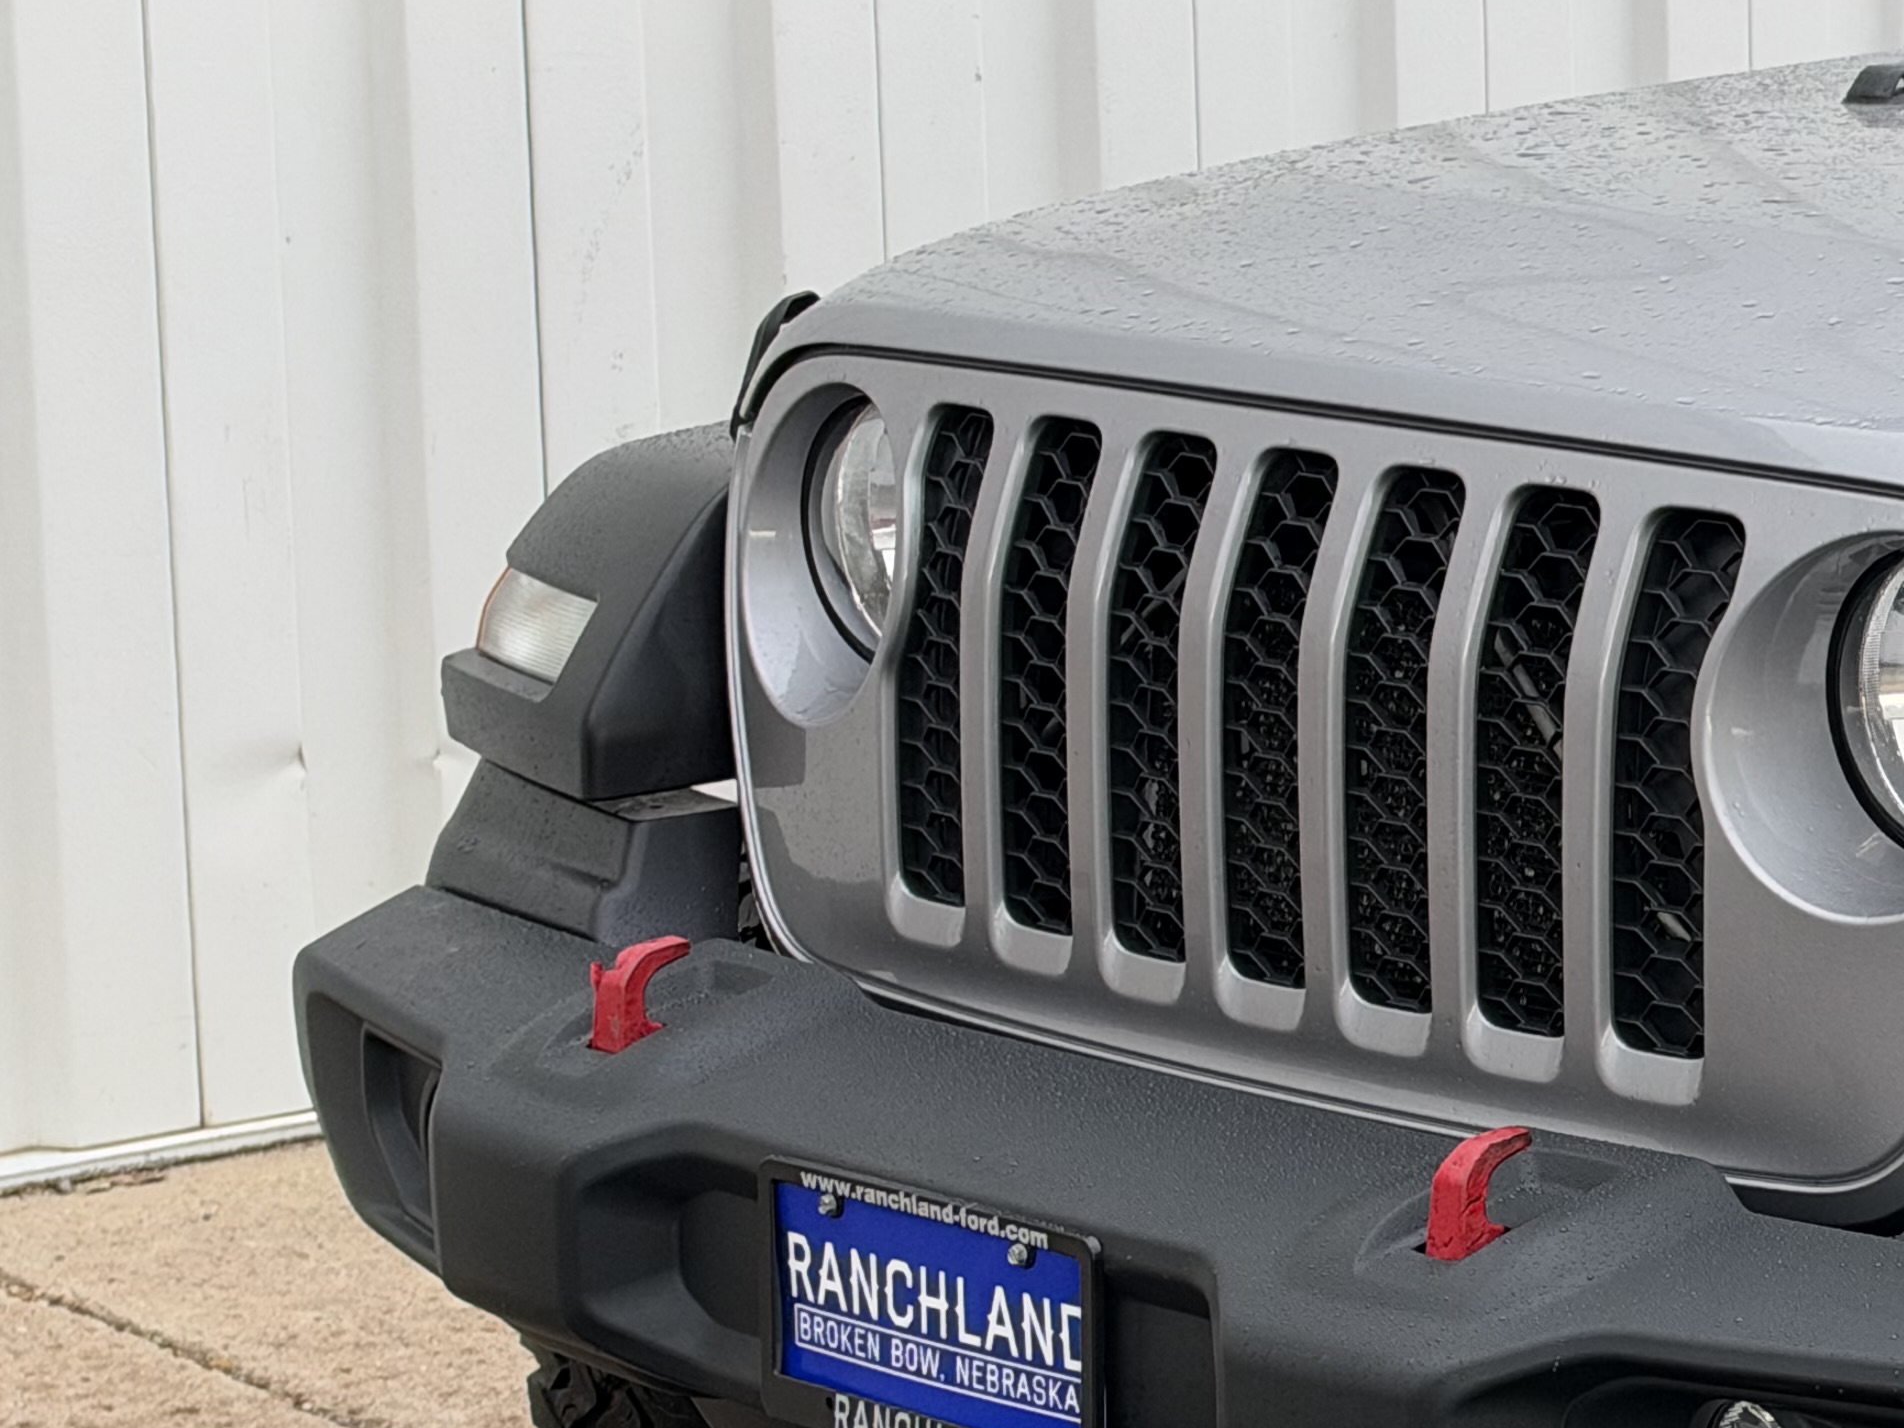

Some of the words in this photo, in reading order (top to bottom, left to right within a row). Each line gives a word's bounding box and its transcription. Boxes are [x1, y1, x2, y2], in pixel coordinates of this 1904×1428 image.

[800, 1170, 1048, 1250] www.ranchland-ford.com
[799, 1310, 880, 1364] BROKEN
[956, 1357, 1081, 1414] NEBRASKA
